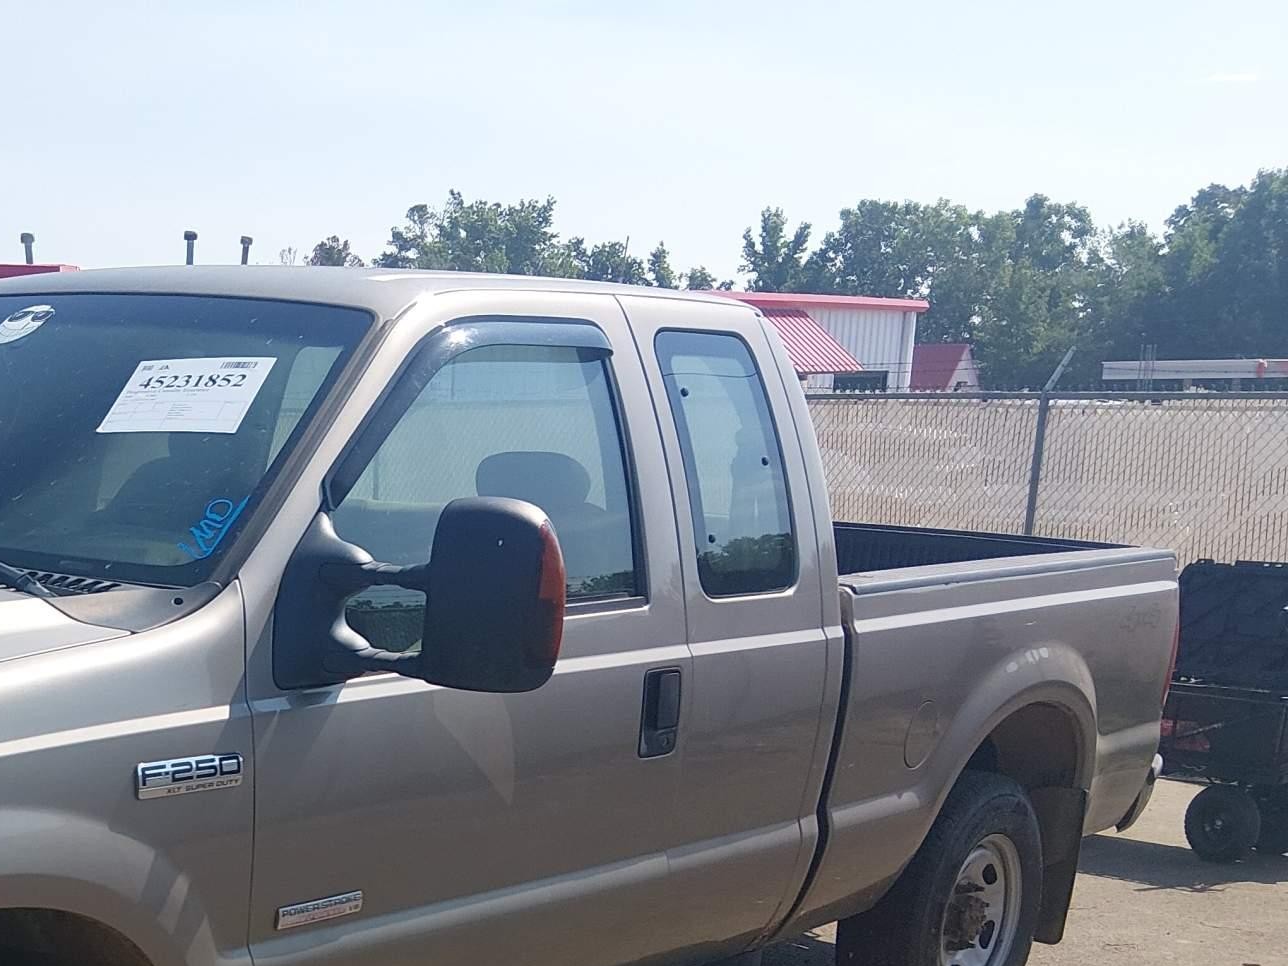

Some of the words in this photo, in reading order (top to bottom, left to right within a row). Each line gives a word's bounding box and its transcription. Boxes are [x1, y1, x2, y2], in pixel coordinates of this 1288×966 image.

[139, 373, 247, 389] 45231852
[141, 755, 241, 786] F-250
[167, 786, 182, 794] XLT
[185, 781, 214, 792] SUPER
[215, 778, 240, 788] DUTY
